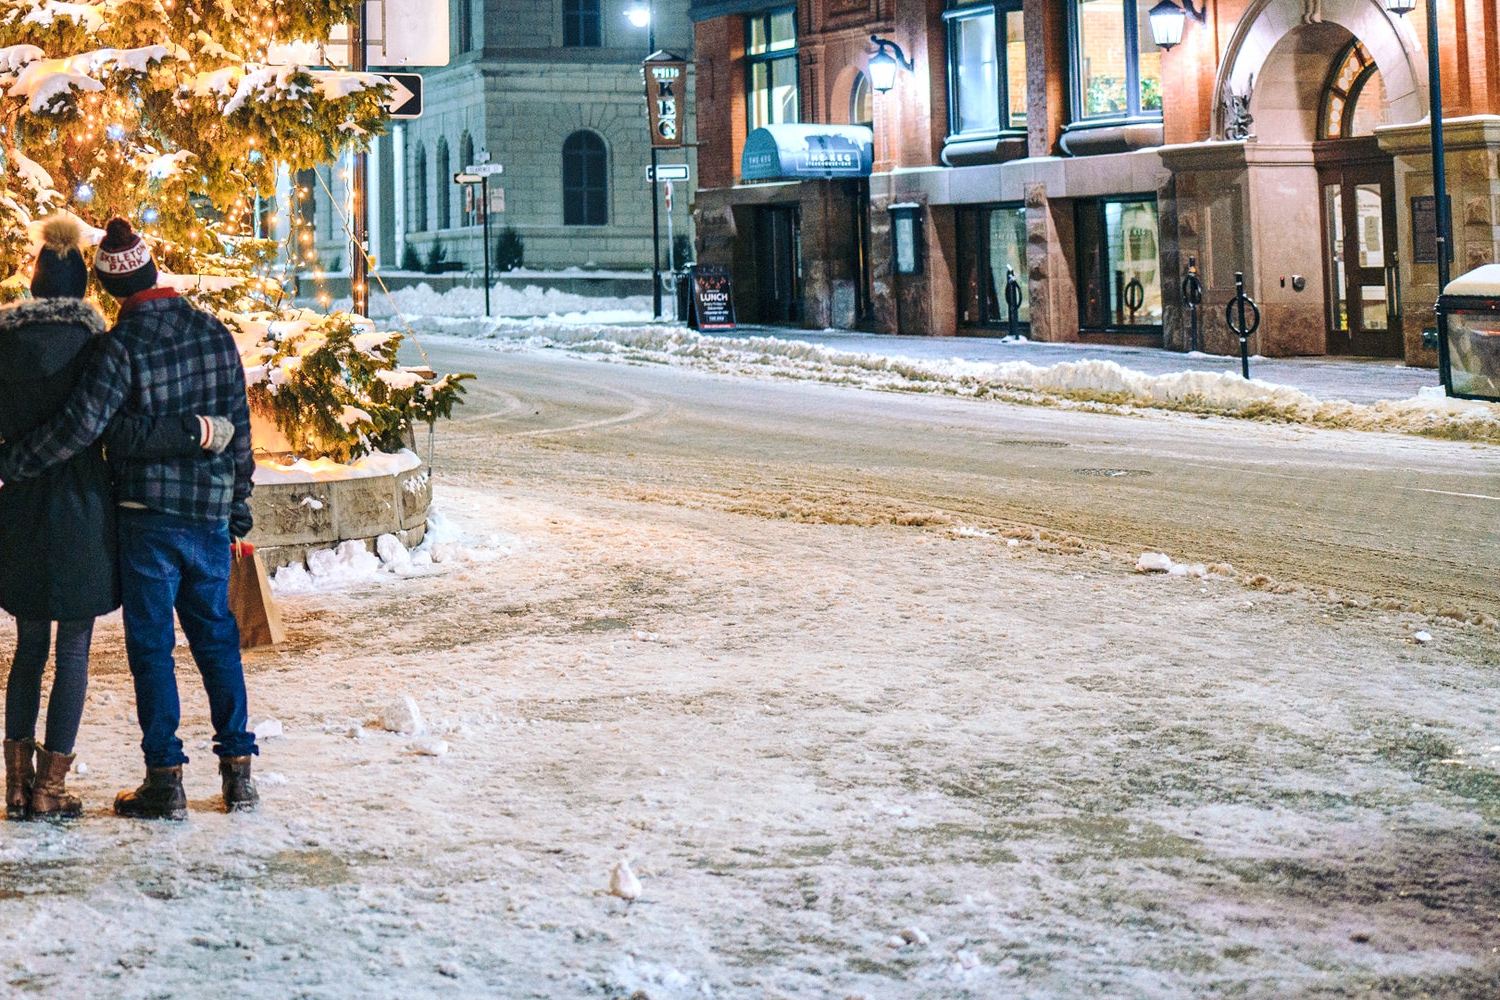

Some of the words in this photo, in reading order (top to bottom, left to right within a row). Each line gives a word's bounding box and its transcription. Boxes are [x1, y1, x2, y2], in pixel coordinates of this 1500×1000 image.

[657, 79, 676, 140] KEG
[100, 245, 146, 263] SKELETON
[109, 257, 144, 271] PARK
[700, 293, 728, 302] LUNCH
